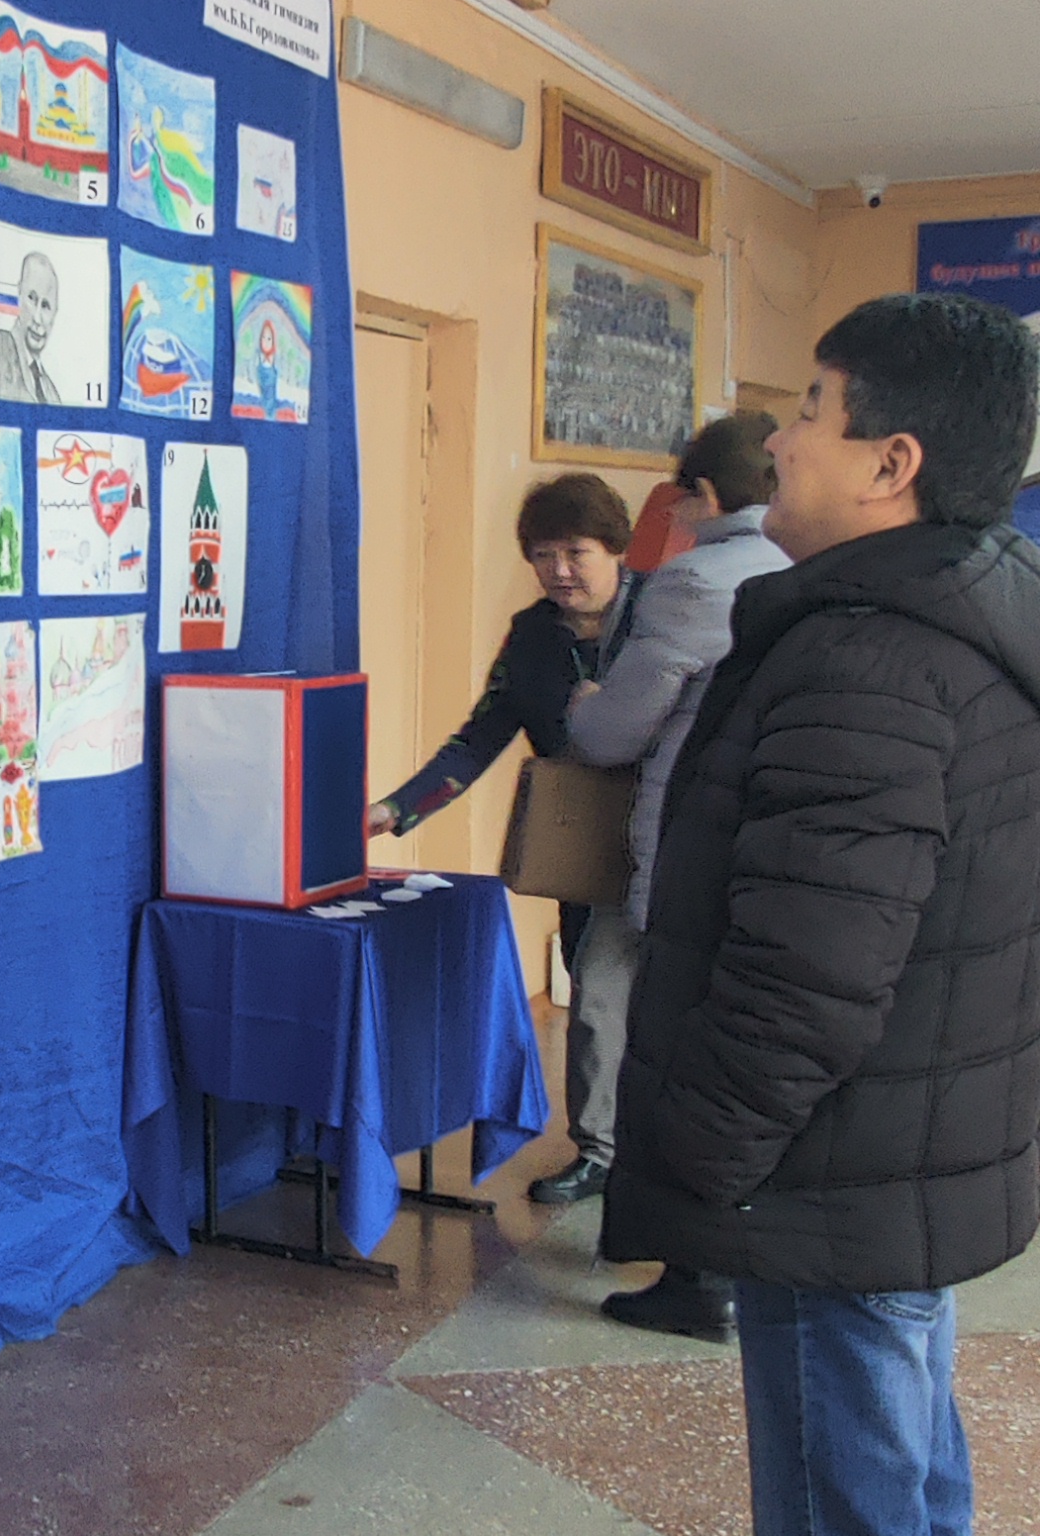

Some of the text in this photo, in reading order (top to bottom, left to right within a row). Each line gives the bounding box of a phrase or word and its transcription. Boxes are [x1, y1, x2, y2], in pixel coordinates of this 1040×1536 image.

[573, 129, 621, 196] ЭТО
[86, 179, 98, 200] 5
[195, 212, 205, 230] 6
[85, 381, 103, 402] 11
[191, 396, 208, 415] 12
[163, 449, 175, 467] 19
